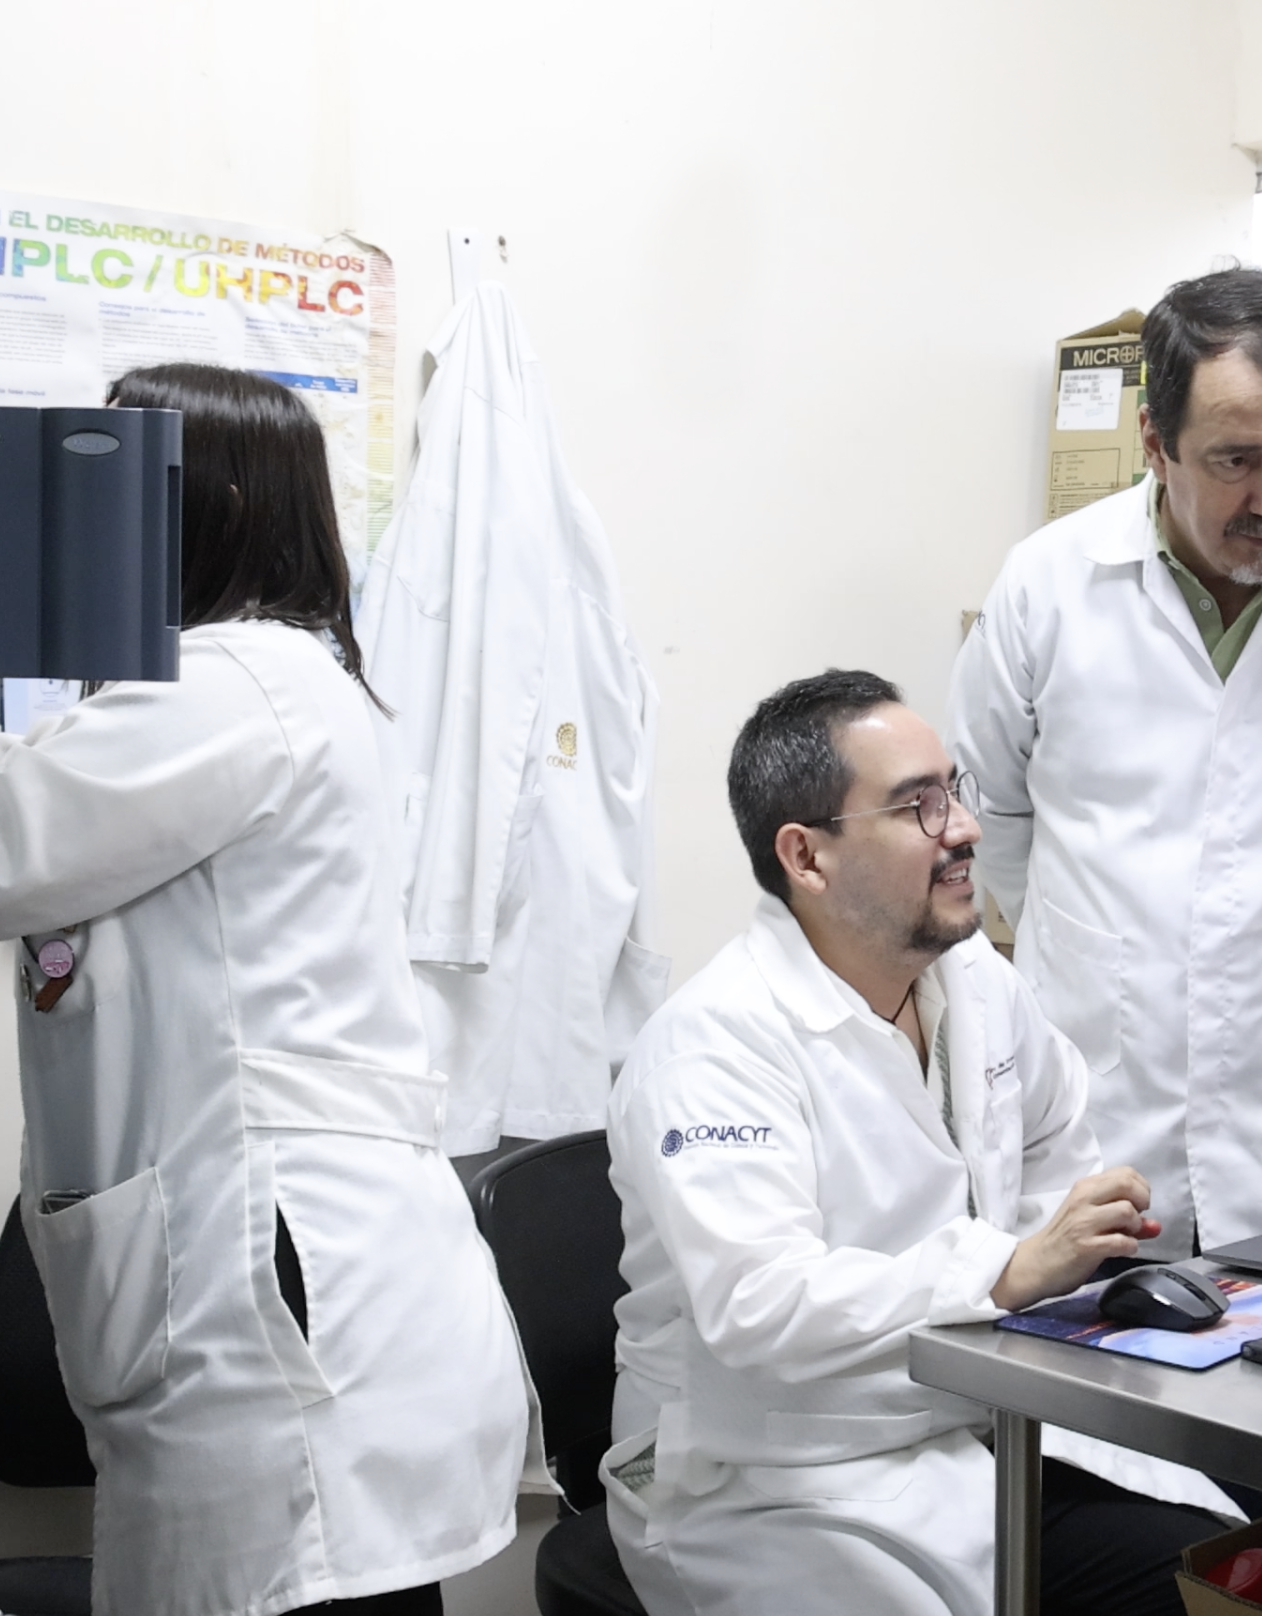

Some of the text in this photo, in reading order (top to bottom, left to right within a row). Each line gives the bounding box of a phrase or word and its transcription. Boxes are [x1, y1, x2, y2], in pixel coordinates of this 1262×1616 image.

[9, 210, 365, 273] EL DESARROLLO DE MÉTODOS
[174, 257, 364, 316] UHPLC
[685, 1124, 772, 1143] CONACYT
